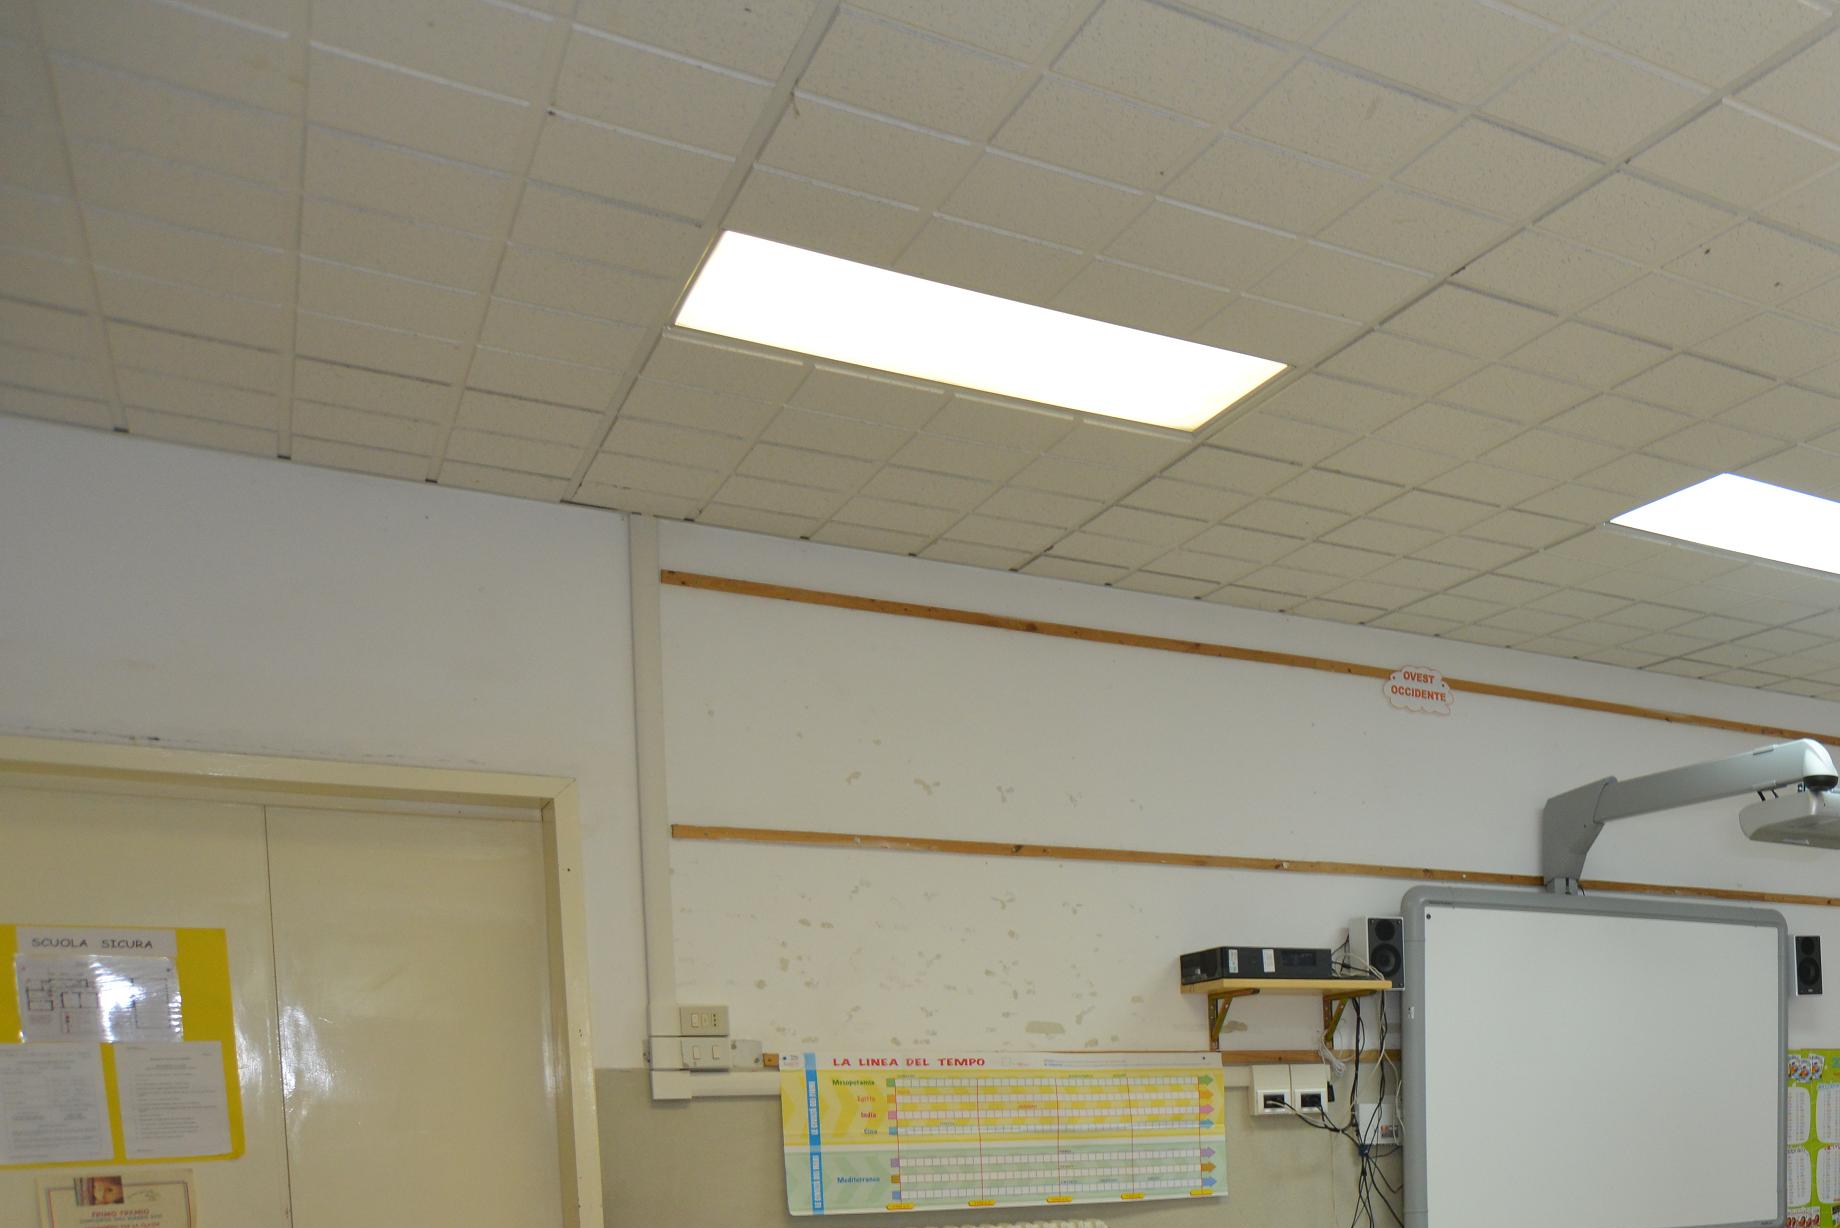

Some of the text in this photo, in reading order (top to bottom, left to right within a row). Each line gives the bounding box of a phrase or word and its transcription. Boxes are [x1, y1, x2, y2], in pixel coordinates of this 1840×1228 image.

[1403, 671, 1435, 684] OVEST
[1391, 685, 1446, 702] OCCIDENTE
[32, 938, 153, 949] SCUOLA SICURA
[833, 1058, 985, 1066] LA LINEA DEL TEMPO
[832, 1079, 875, 1087] Mesopotamia
